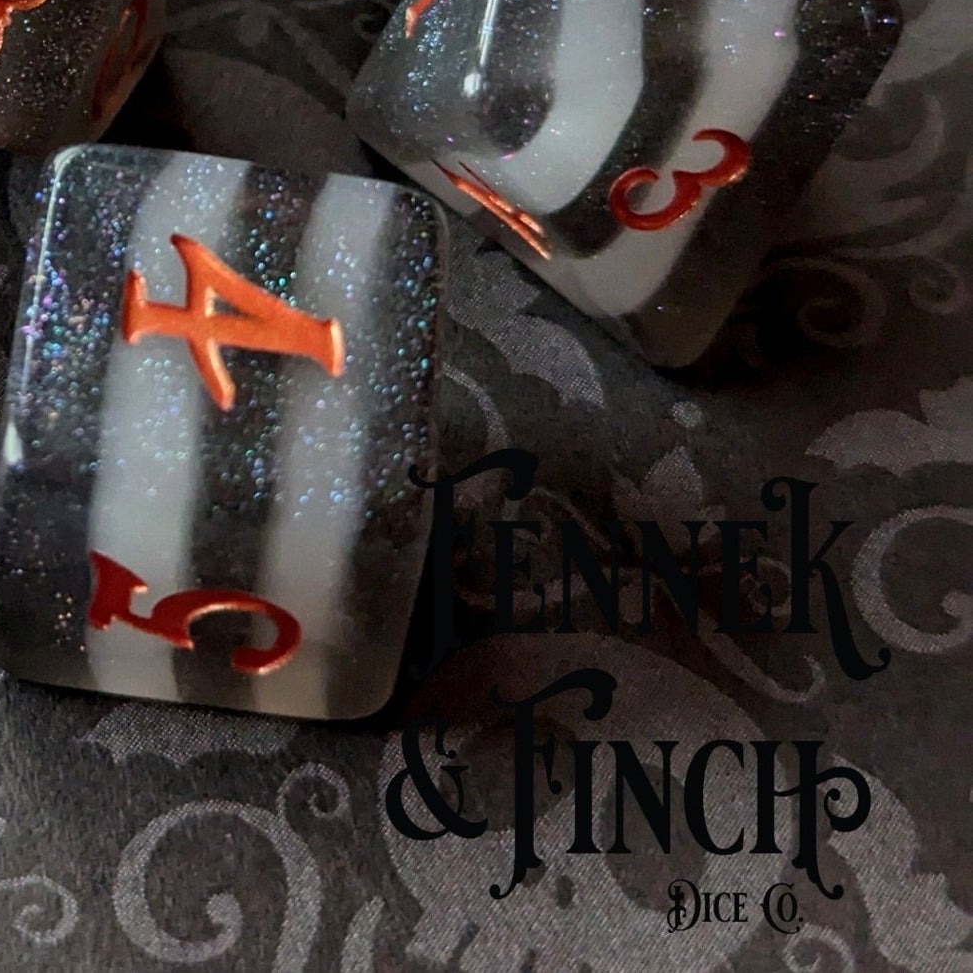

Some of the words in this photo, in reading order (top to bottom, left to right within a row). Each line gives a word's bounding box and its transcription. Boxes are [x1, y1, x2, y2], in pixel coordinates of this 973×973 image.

[610, 128, 751, 233] 3
[121, 235, 344, 411] 4
[87, 553, 303, 676] 5
